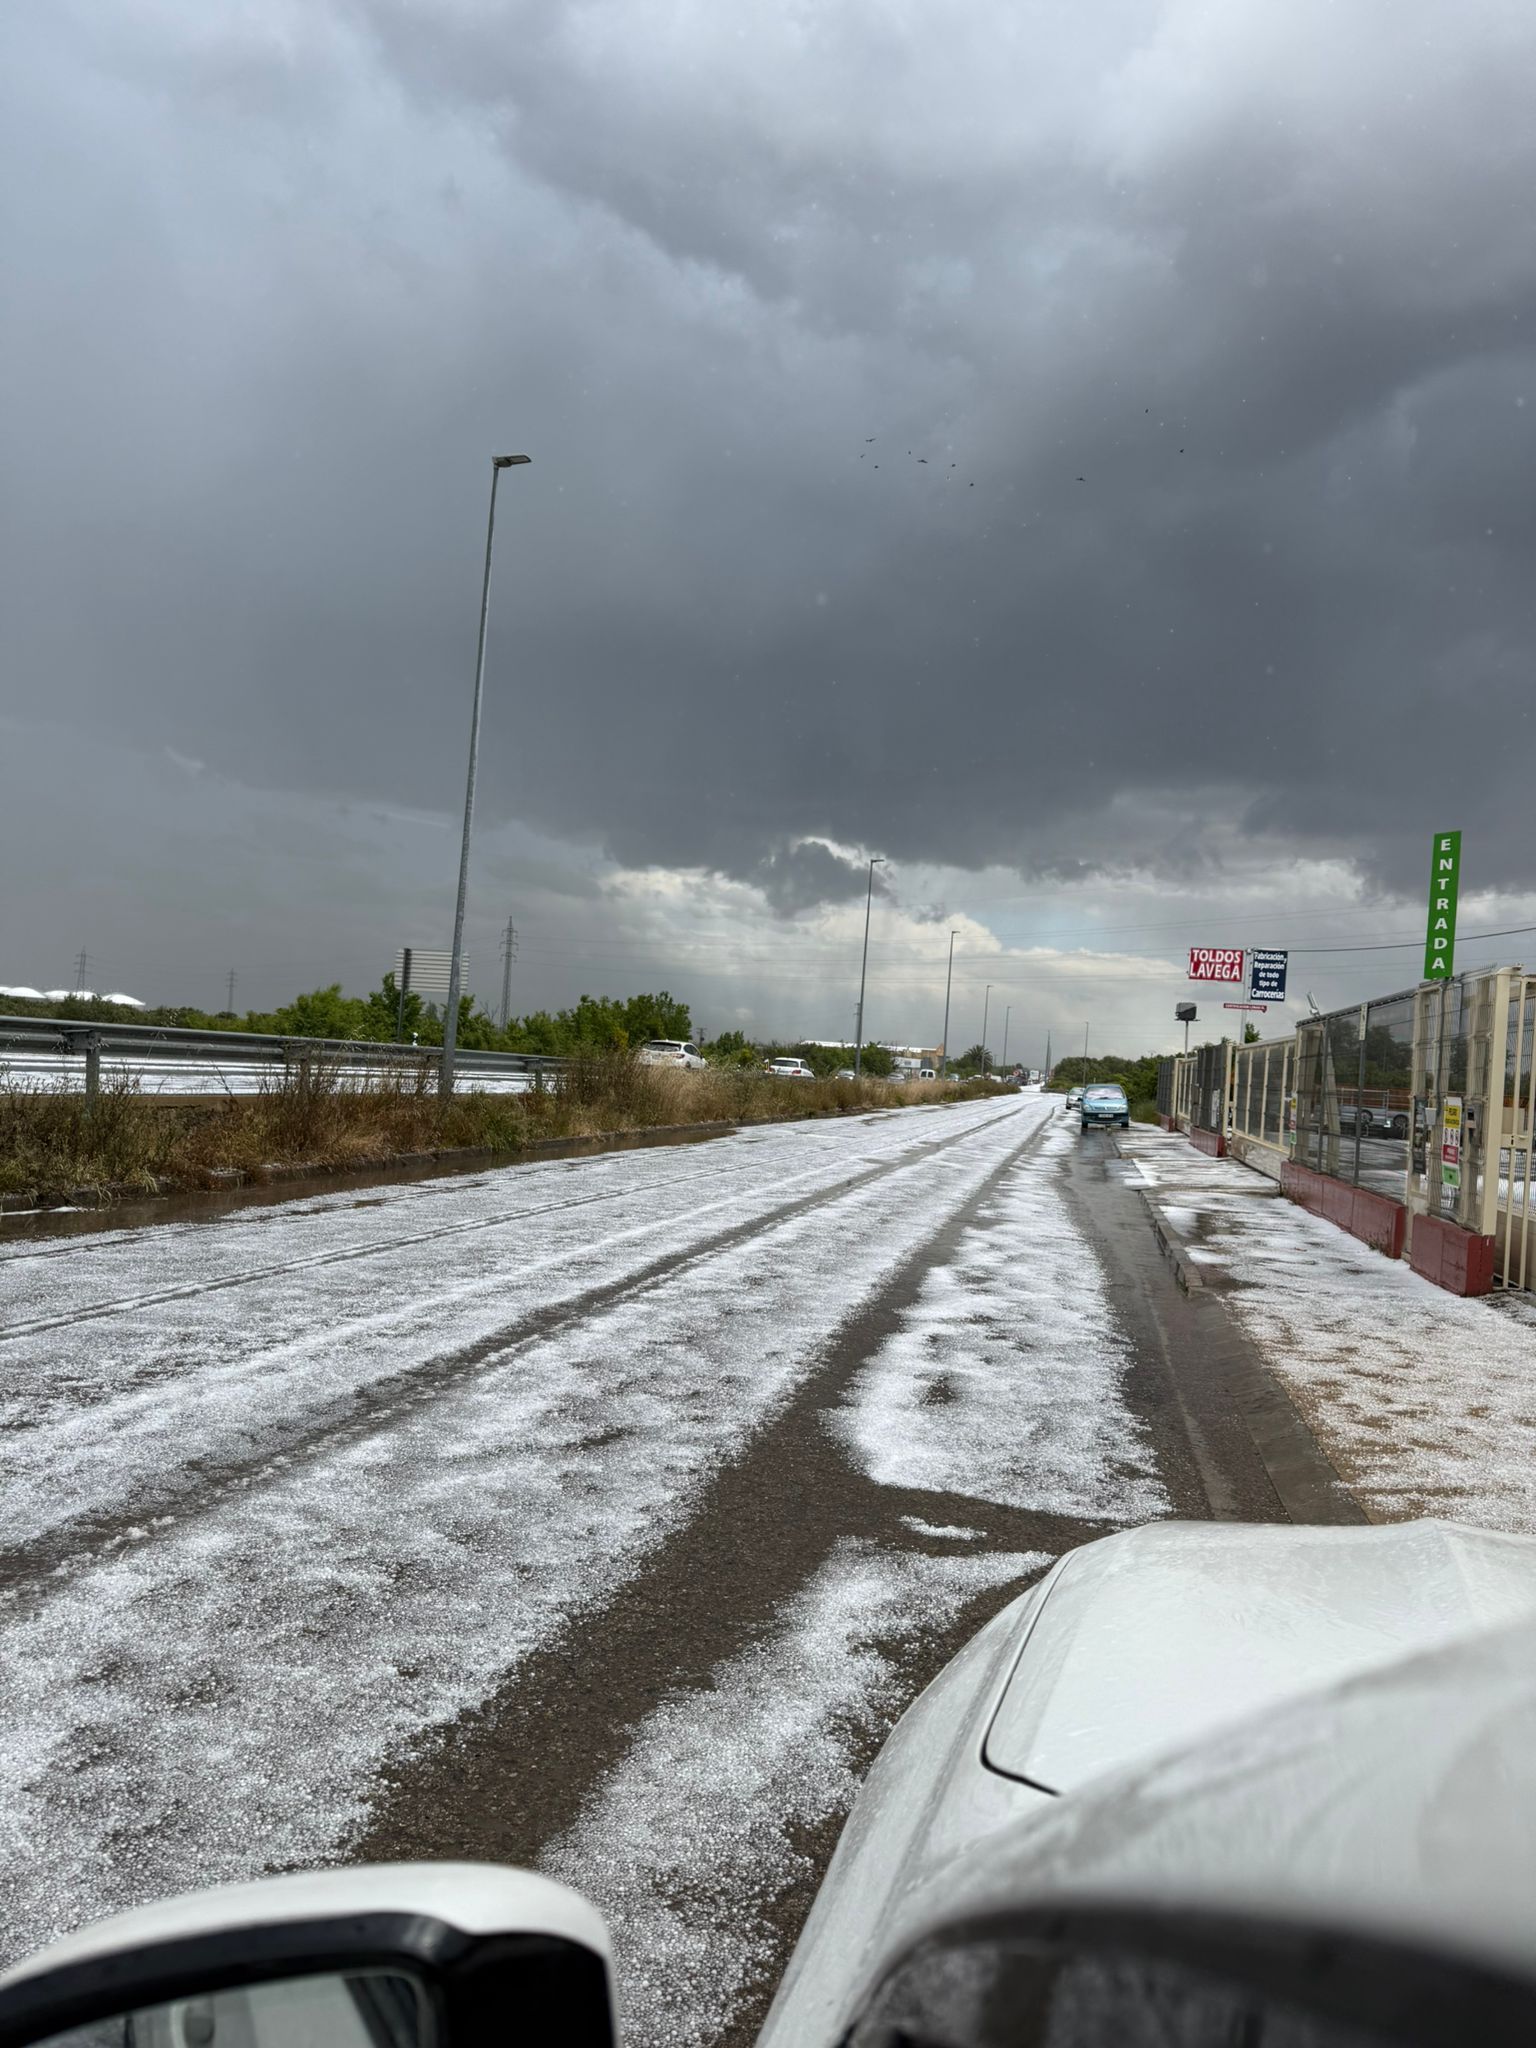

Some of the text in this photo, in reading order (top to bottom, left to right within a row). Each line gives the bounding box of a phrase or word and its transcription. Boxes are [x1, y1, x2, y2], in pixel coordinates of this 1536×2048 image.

[1431, 838, 1453, 969] ENTRADA
[1192, 949, 1241, 963] TOLDOS
[1190, 962, 1240, 979] LAVEGA
[1254, 961, 1285, 971] Reparación
